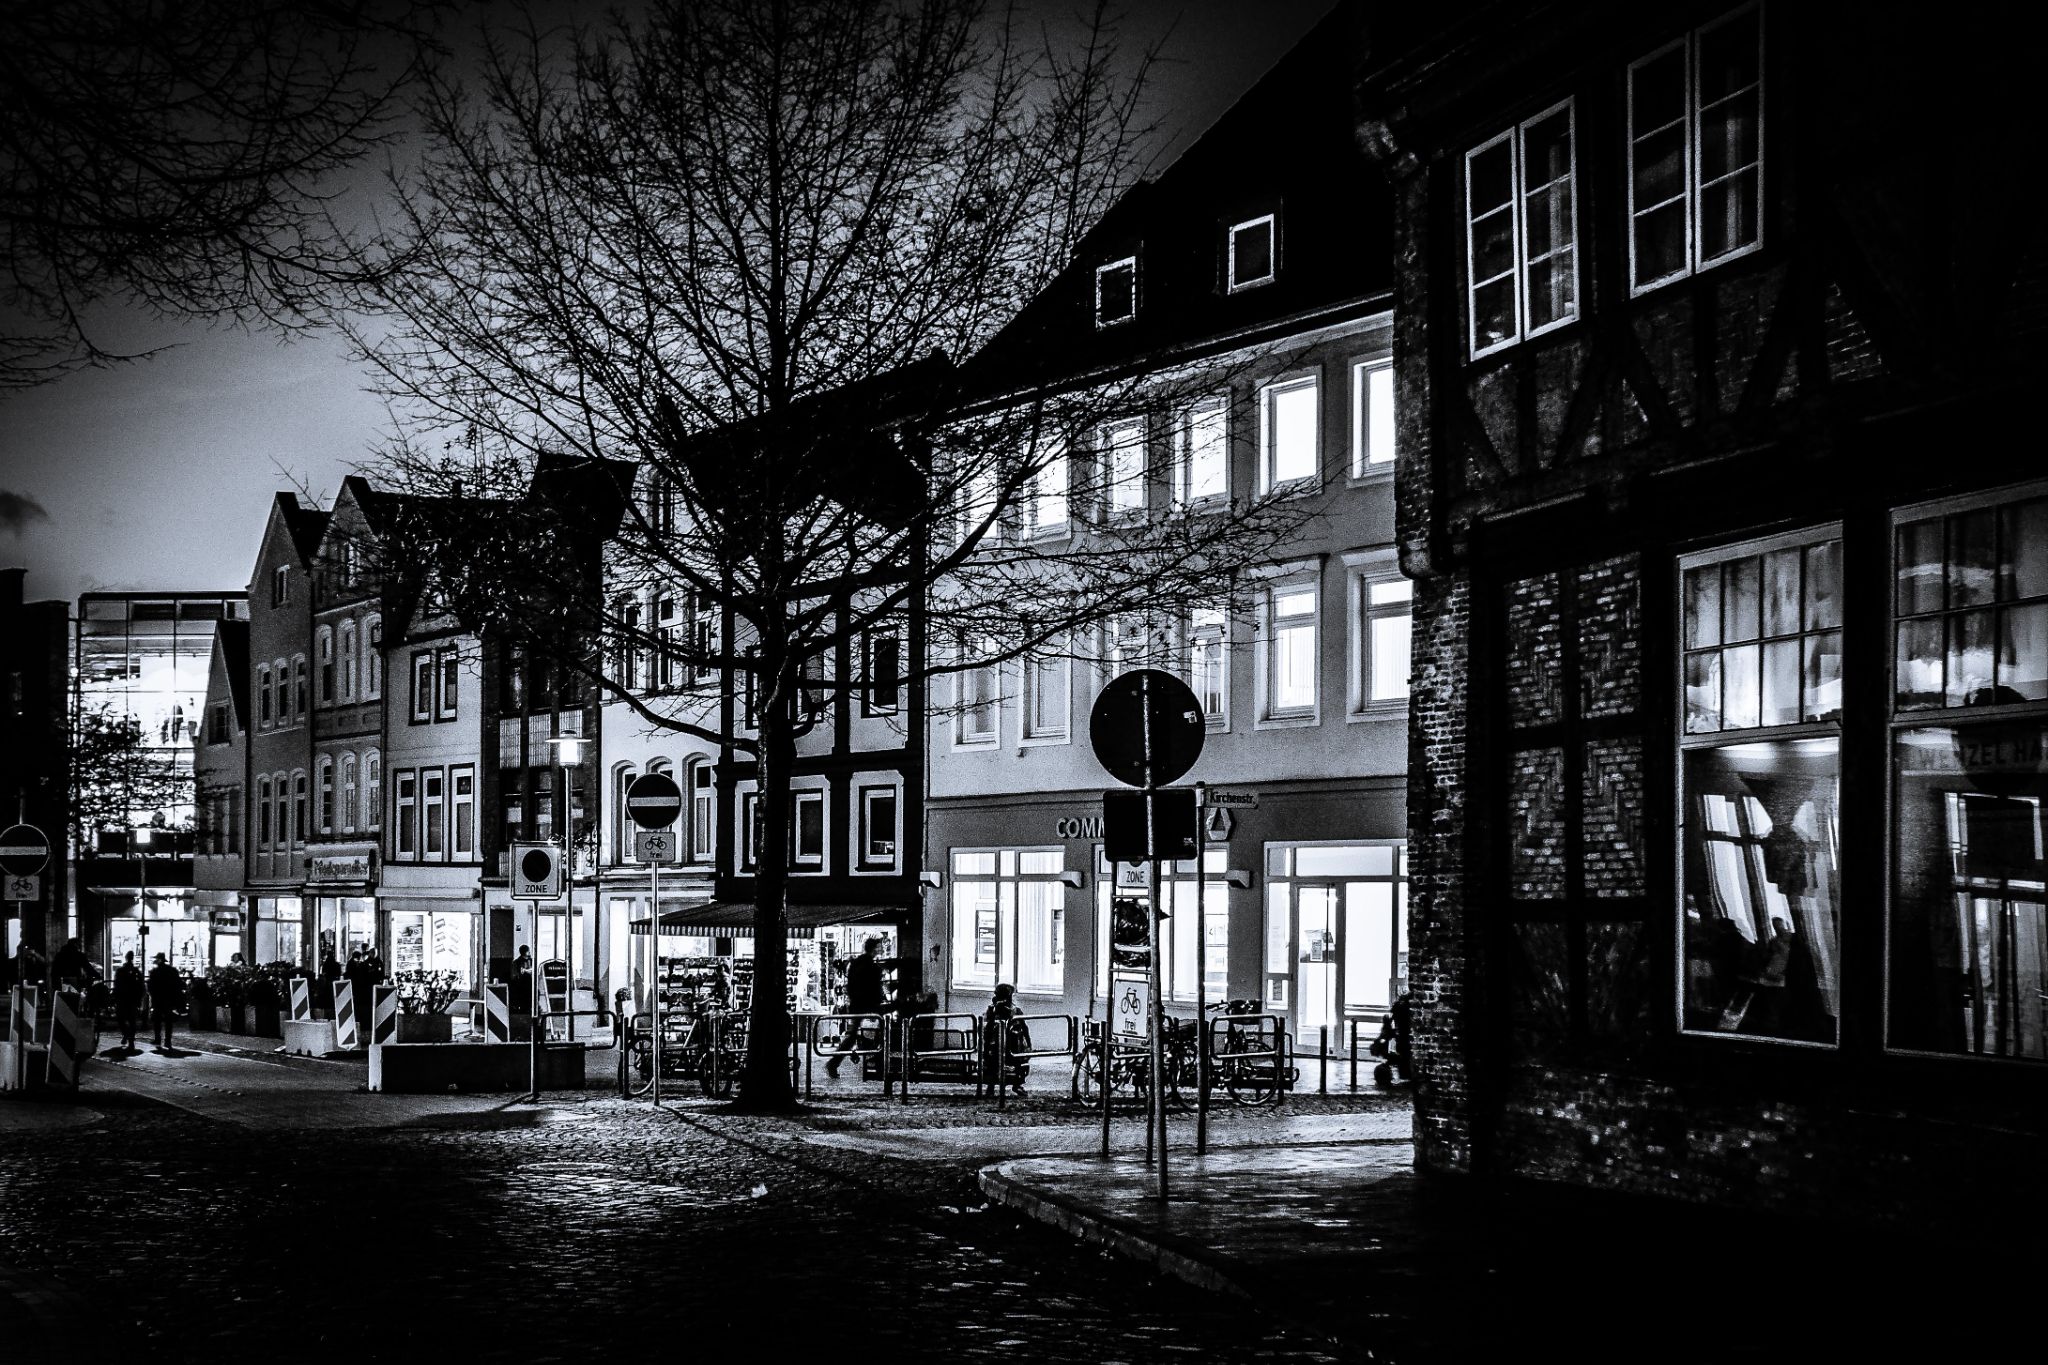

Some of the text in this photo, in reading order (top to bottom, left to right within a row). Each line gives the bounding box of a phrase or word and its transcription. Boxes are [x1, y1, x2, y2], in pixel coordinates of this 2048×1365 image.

[2014, 738, 2048, 762] HA
[1209, 790, 1256, 805] Kirchenstr.
[1126, 870, 1145, 884] ZONE
[525, 884, 548, 893] ZONE
[1124, 1018, 1137, 1031] frei
